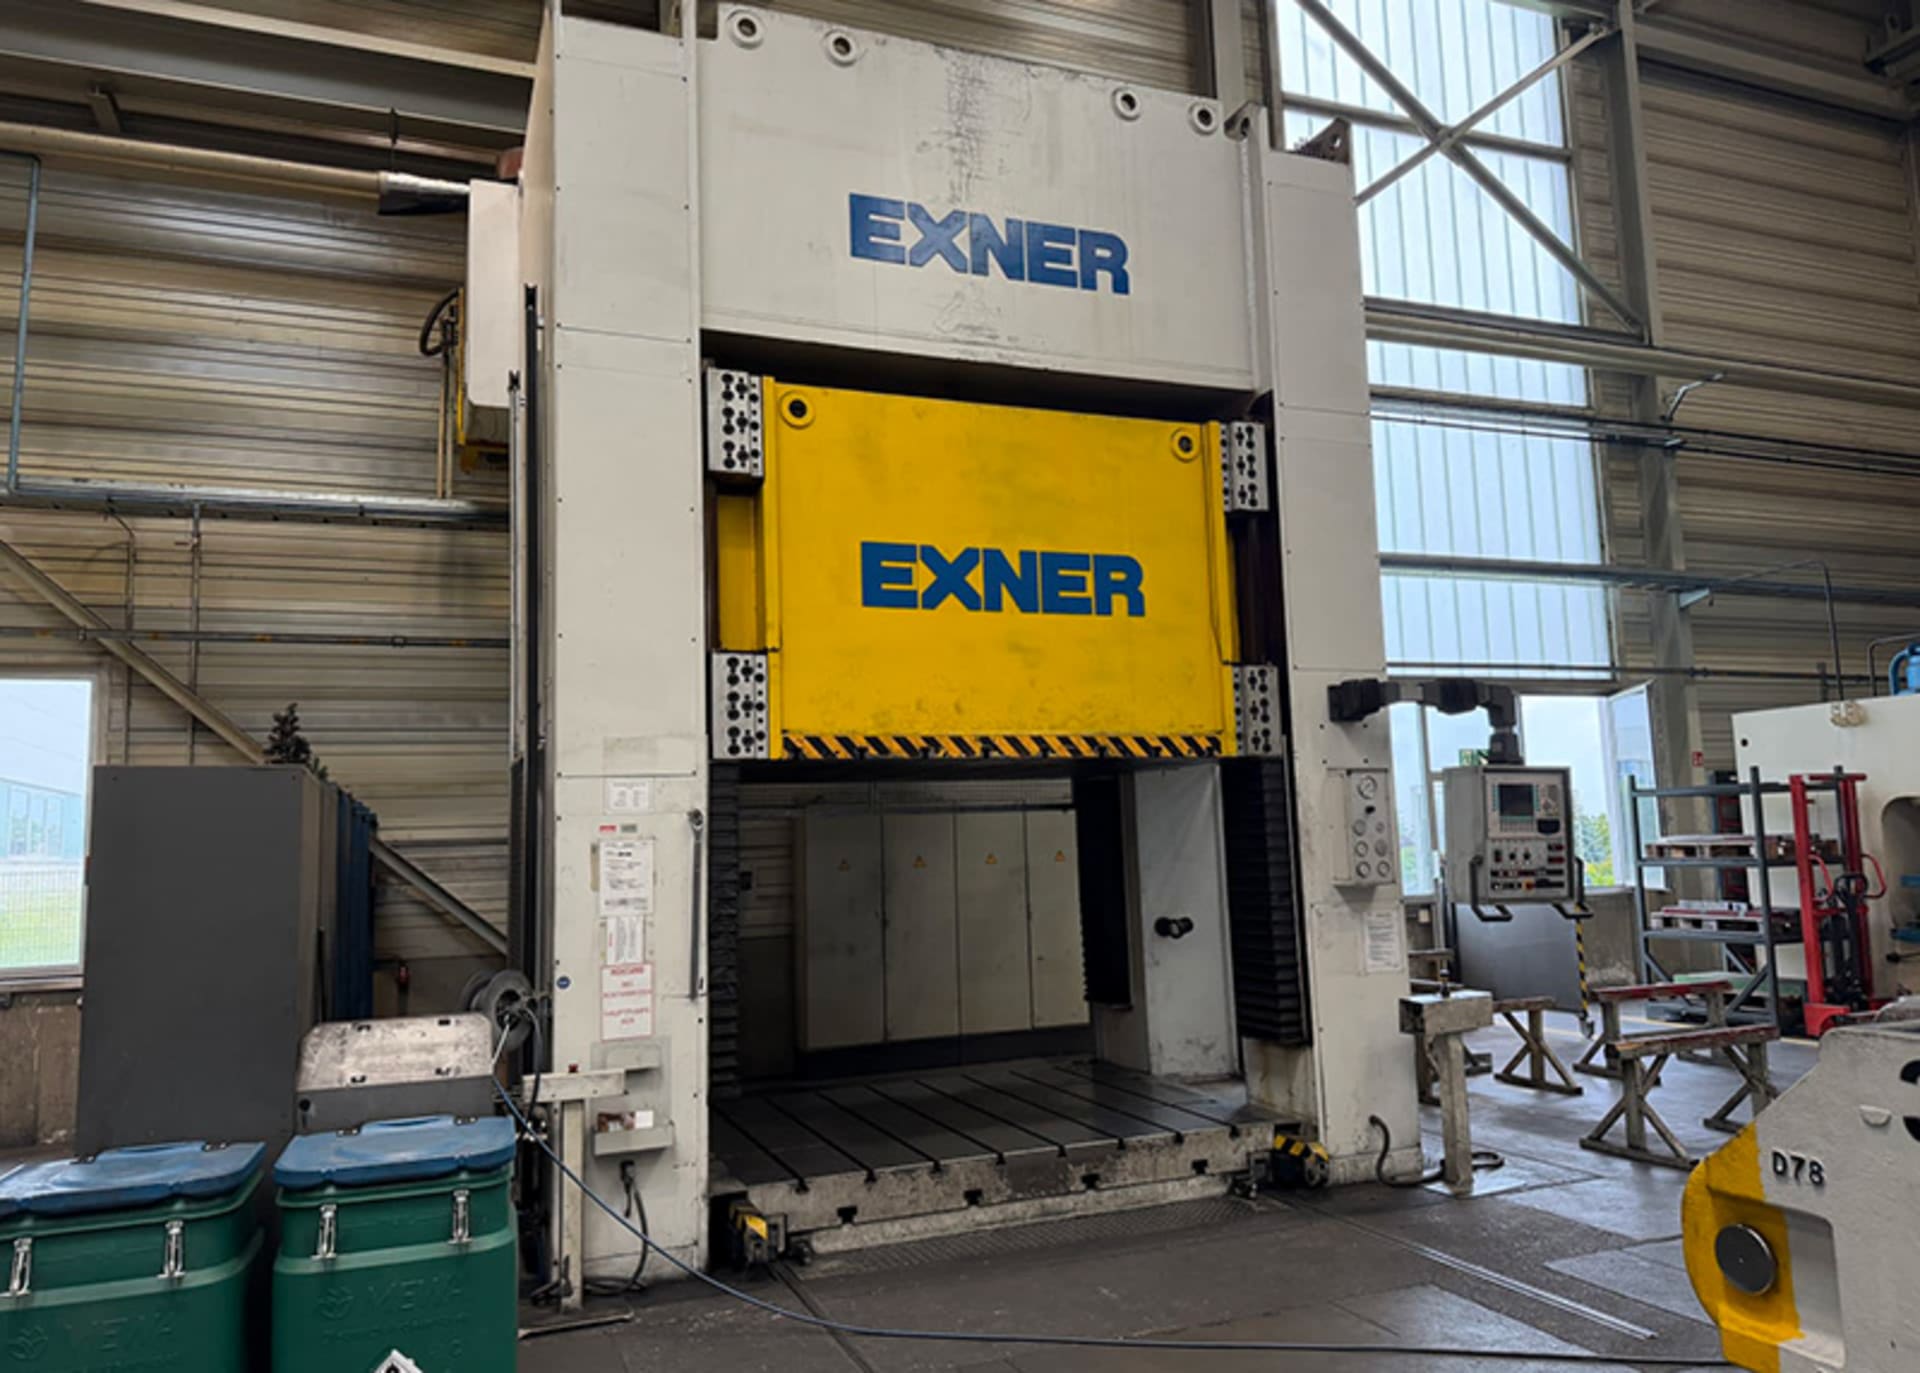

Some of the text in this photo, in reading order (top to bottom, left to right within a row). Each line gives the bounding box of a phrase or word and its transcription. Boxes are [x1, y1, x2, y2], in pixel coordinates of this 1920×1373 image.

[849, 192, 1130, 295] EXNER
[861, 541, 1146, 617] EXNER
[1771, 1150, 1825, 1185] D78
